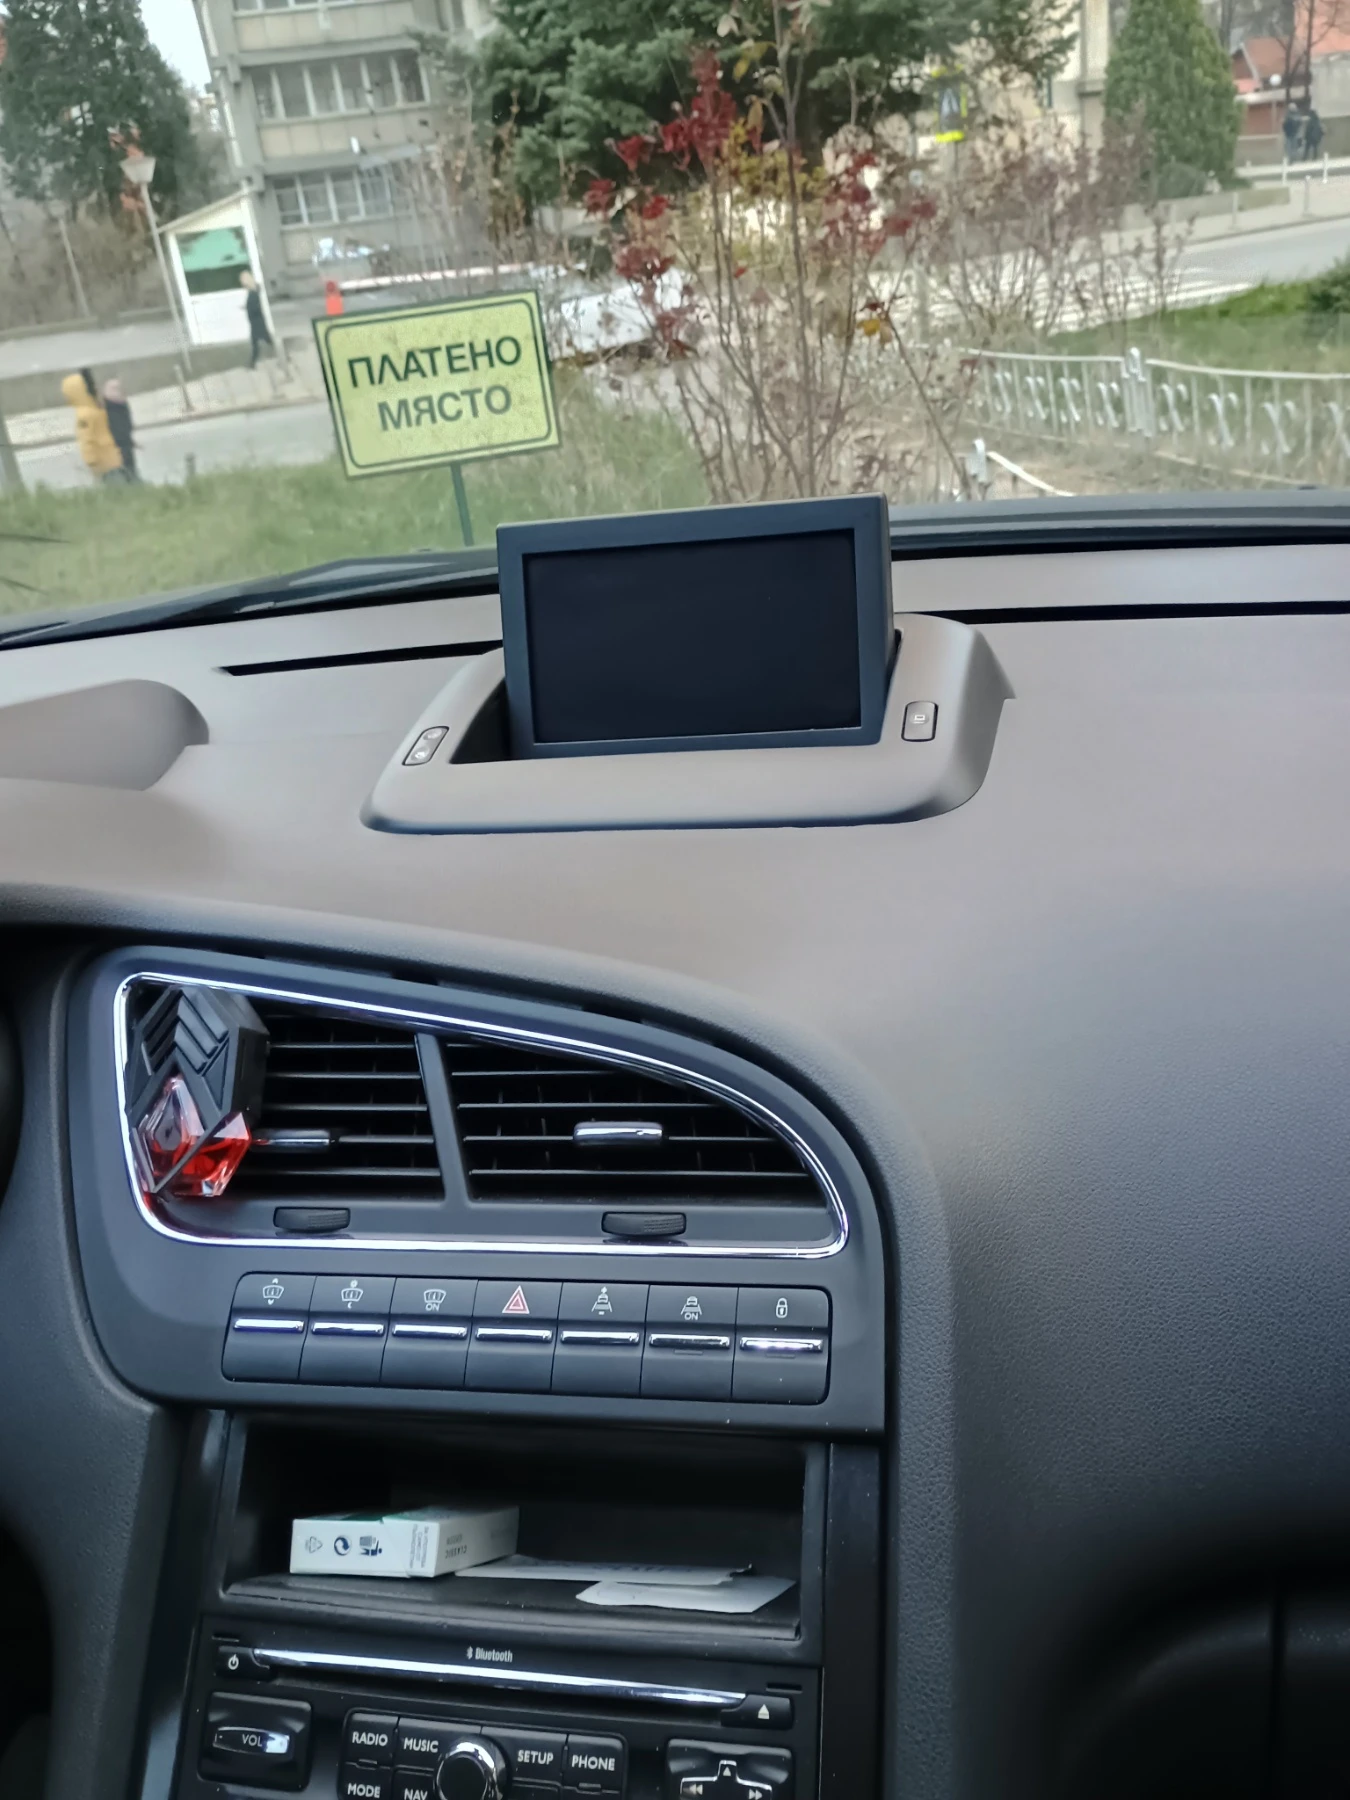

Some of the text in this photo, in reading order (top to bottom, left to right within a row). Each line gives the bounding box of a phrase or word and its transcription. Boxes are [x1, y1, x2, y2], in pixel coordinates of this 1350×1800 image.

[348, 336, 522, 388] ПЛАТЕНО
[377, 385, 512, 432] МЯСТО
[425, 1303, 440, 1312] ON
[684, 1312, 699, 1321] ON
[475, 1646, 513, 1663] Bluetooth
[241, 1733, 263, 1747] VOL
[351, 1731, 388, 1747] RADIO
[403, 1737, 439, 1753] MUSIC
[517, 1749, 554, 1765] SETUP
[571, 1754, 616, 1771] PHONE
[347, 1782, 381, 1798] MODE
[403, 1787, 428, 1800] NAV
